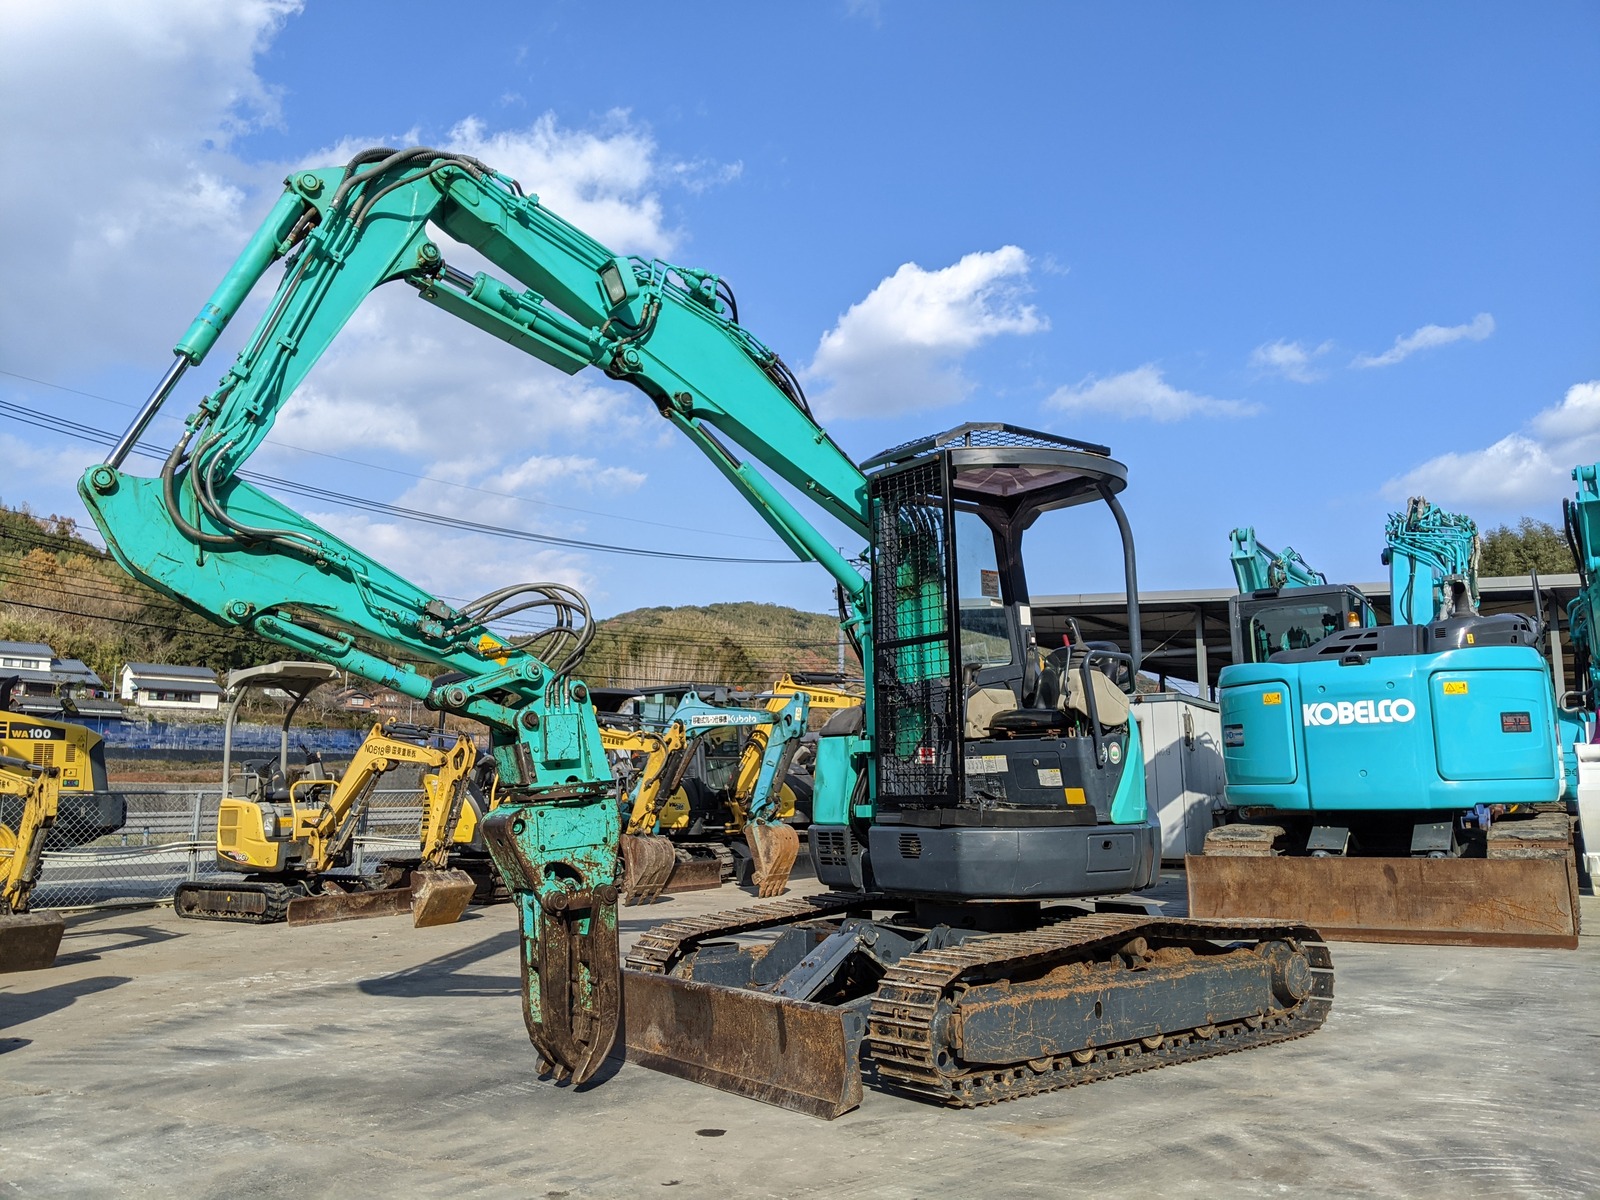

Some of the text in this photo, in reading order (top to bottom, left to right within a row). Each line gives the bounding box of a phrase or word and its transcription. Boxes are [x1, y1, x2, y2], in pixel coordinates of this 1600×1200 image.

[1303, 698, 1416, 727] KOBELCO
[728, 714, 757, 723] Kubota
[11, 728, 52, 739] WA100
